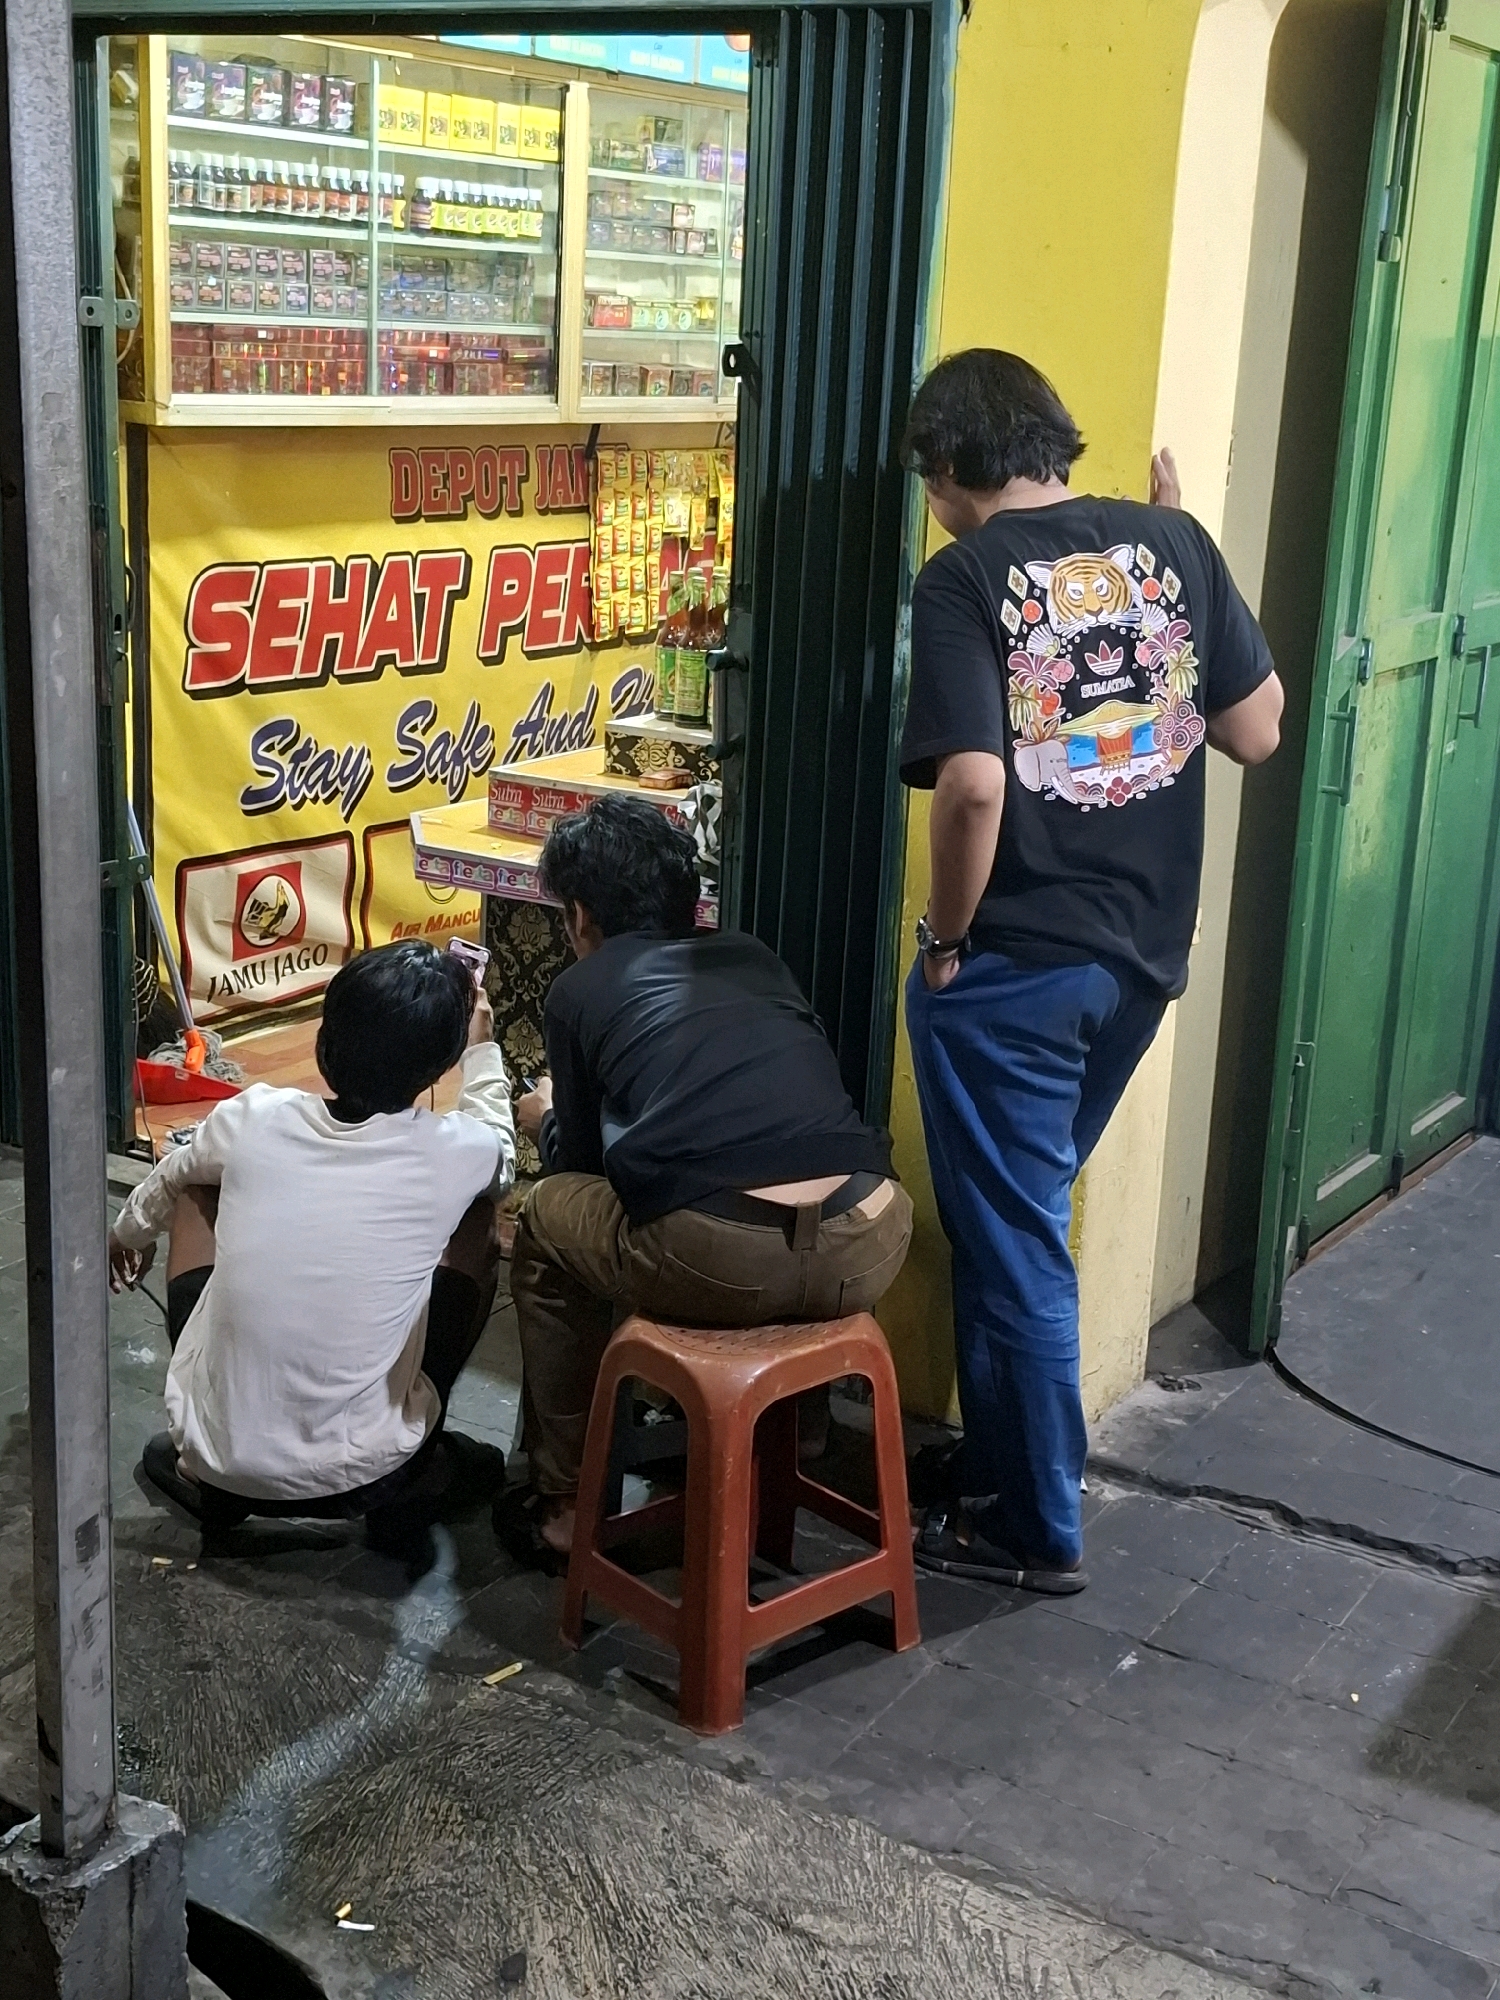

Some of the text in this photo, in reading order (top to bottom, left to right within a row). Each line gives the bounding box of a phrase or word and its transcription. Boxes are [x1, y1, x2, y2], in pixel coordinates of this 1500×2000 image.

[389, 445, 528, 521] DEPOT
[184, 549, 468, 694] SEHAT
[240, 717, 373, 820] Stay
[385, 698, 495, 802] Safe
[501, 681, 598, 765] And
[206, 942, 329, 1003] JAMU JAGO
